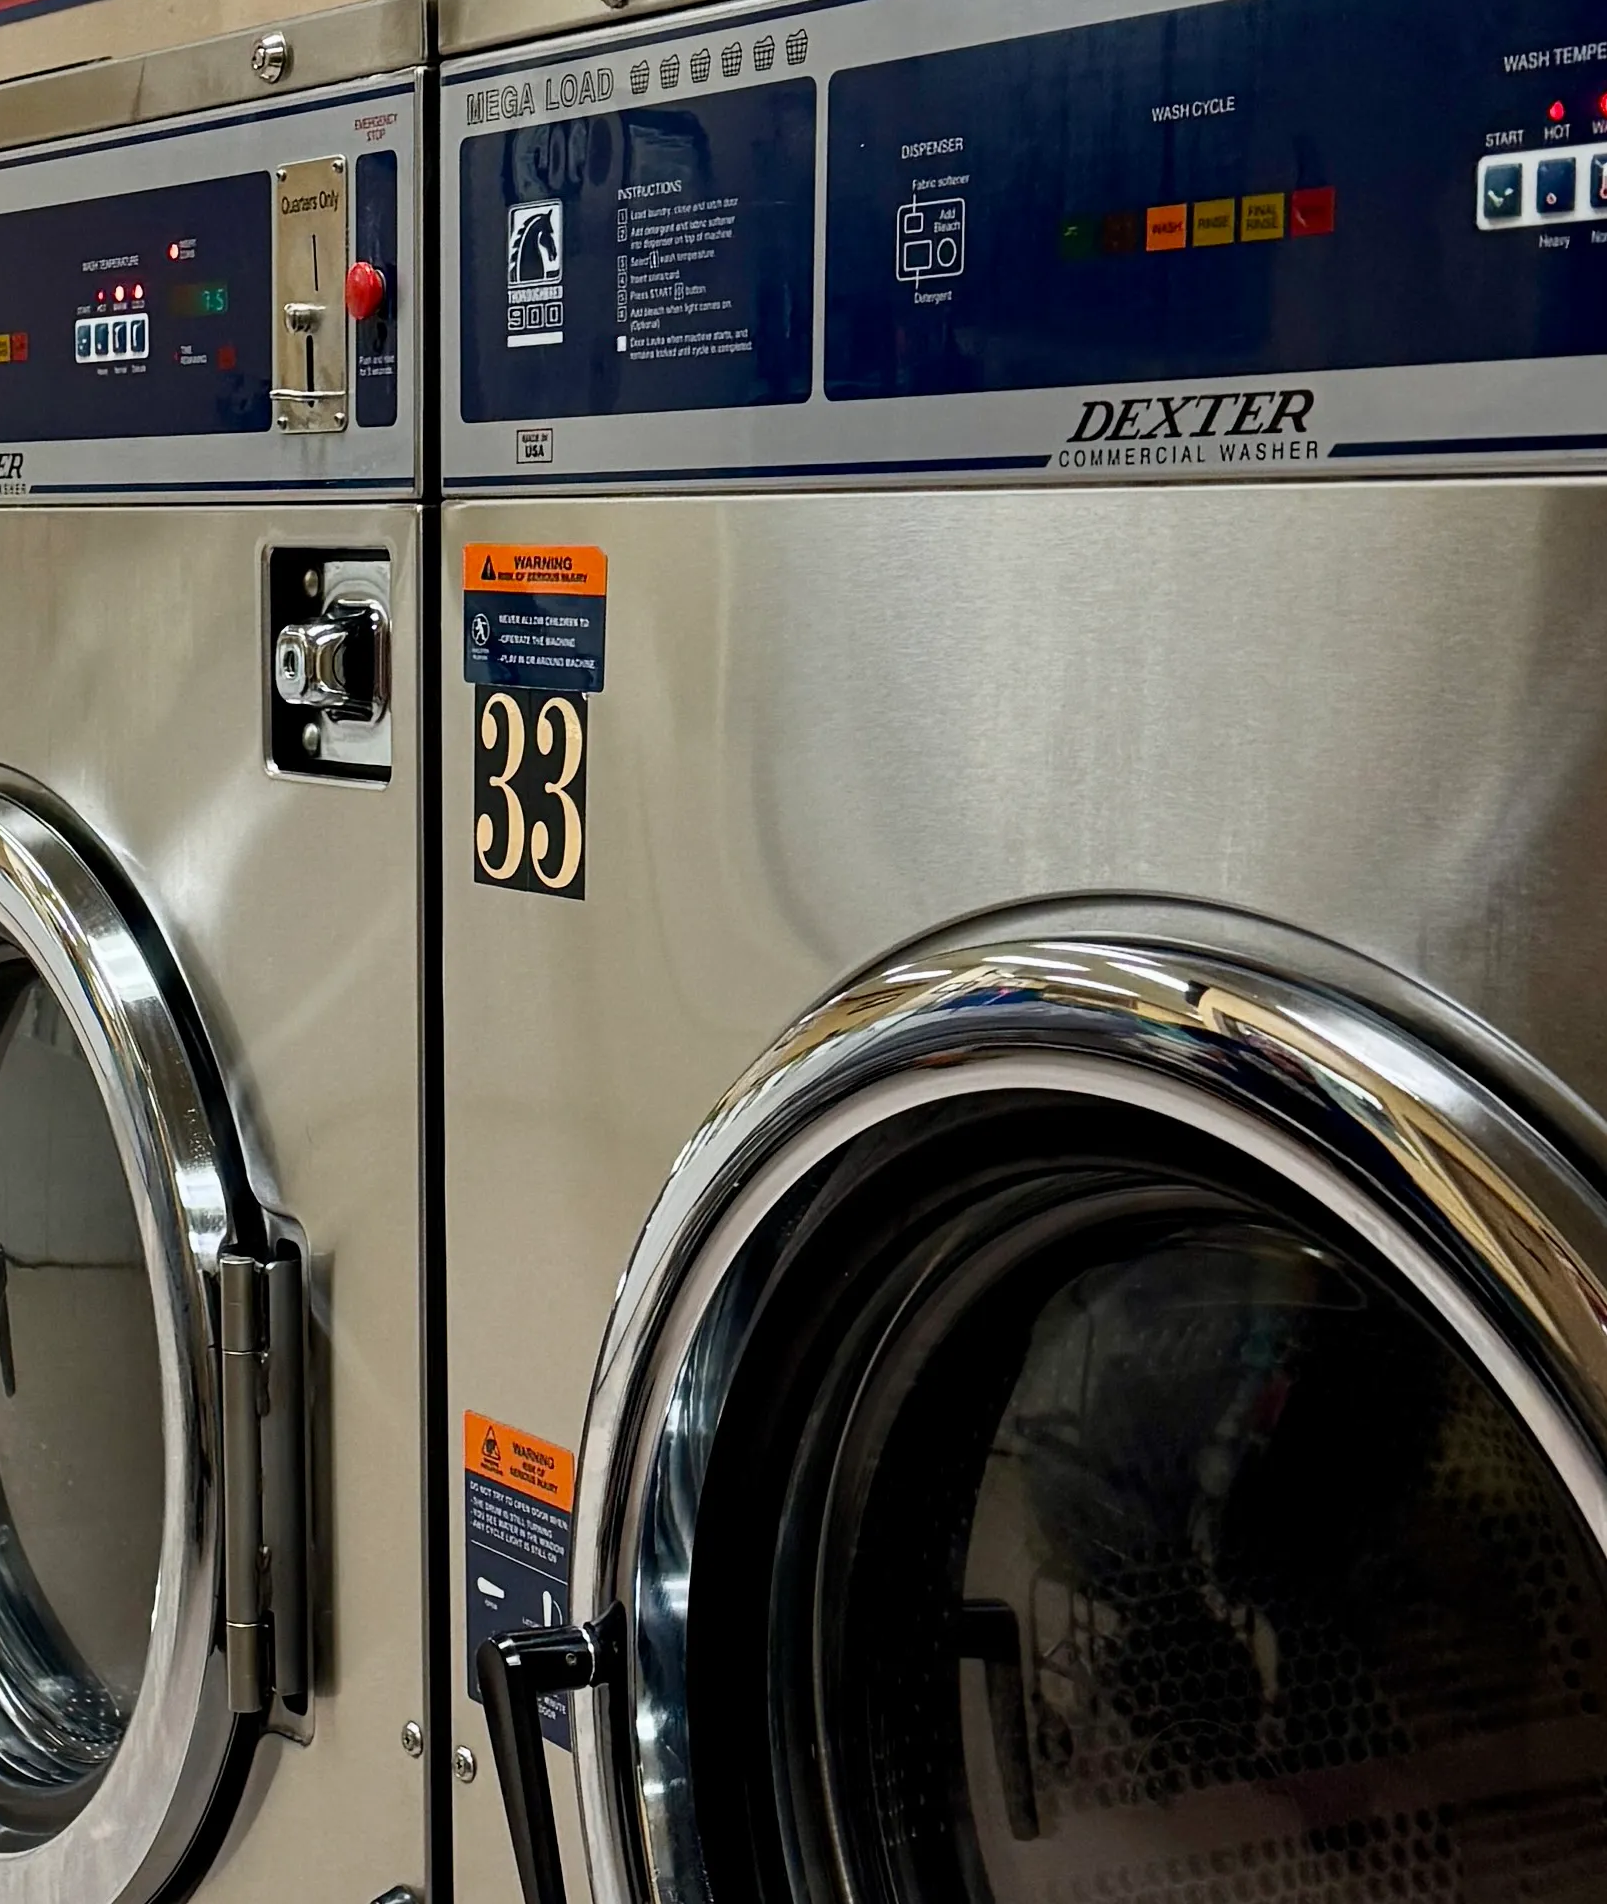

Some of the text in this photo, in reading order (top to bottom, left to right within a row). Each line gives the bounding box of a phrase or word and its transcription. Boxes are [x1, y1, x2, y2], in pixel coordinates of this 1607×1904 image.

[1503, 50, 1550, 73] WASH
[466, 67, 615, 126] MEGA LOAD
[1151, 96, 1236, 122] WASH CYCLE
[354, 113, 398, 130] EMERGENCY
[367, 128, 386, 142] STOP
[1485, 129, 1524, 148] START
[1544, 123, 1571, 140] HOT
[901, 137, 964, 159] DISPENSER
[618, 179, 682, 201] INSTRUCTIONS
[912, 174, 970, 192] Fabric softener
[281, 189, 339, 215] Quarters Only
[1247, 203, 1277, 218] FINAL
[939, 207, 956, 220] Add
[1198, 214, 1231, 231] RINSE
[1152, 220, 1184, 235] WASH
[1246, 215, 1279, 231] RINSE
[1539, 234, 1571, 249] Heavy
[650, 287, 673, 299] START
[914, 291, 953, 305] Detergent
[507, 302, 564, 330] 900
[1066, 389, 1315, 443] DEXTER
[525, 444, 545, 458] USA
[1058, 440, 1319, 468] COMMERCIAL WASHER
[514, 555, 573, 571] WARNING
[476, 692, 583, 889] 33
[512, 1441, 555, 1470] WARNING
[470, 1480, 479, 1492] DO
[480, 1484, 492, 1496] NOT
[493, 1489, 505, 1502] TRY
[505, 1495, 513, 1507] TO
[513, 1499, 531, 1514] OPEN
[531, 1506, 549, 1522] DOOR
[509, 1511, 526, 1526] STILL
[498, 1519, 518, 1537] WATER
[486, 1524, 505, 1541] CYCLE
[505, 1532, 523, 1548] LIGHT
[531, 1544, 547, 1560] STILL
[547, 1551, 558, 1564] ON
